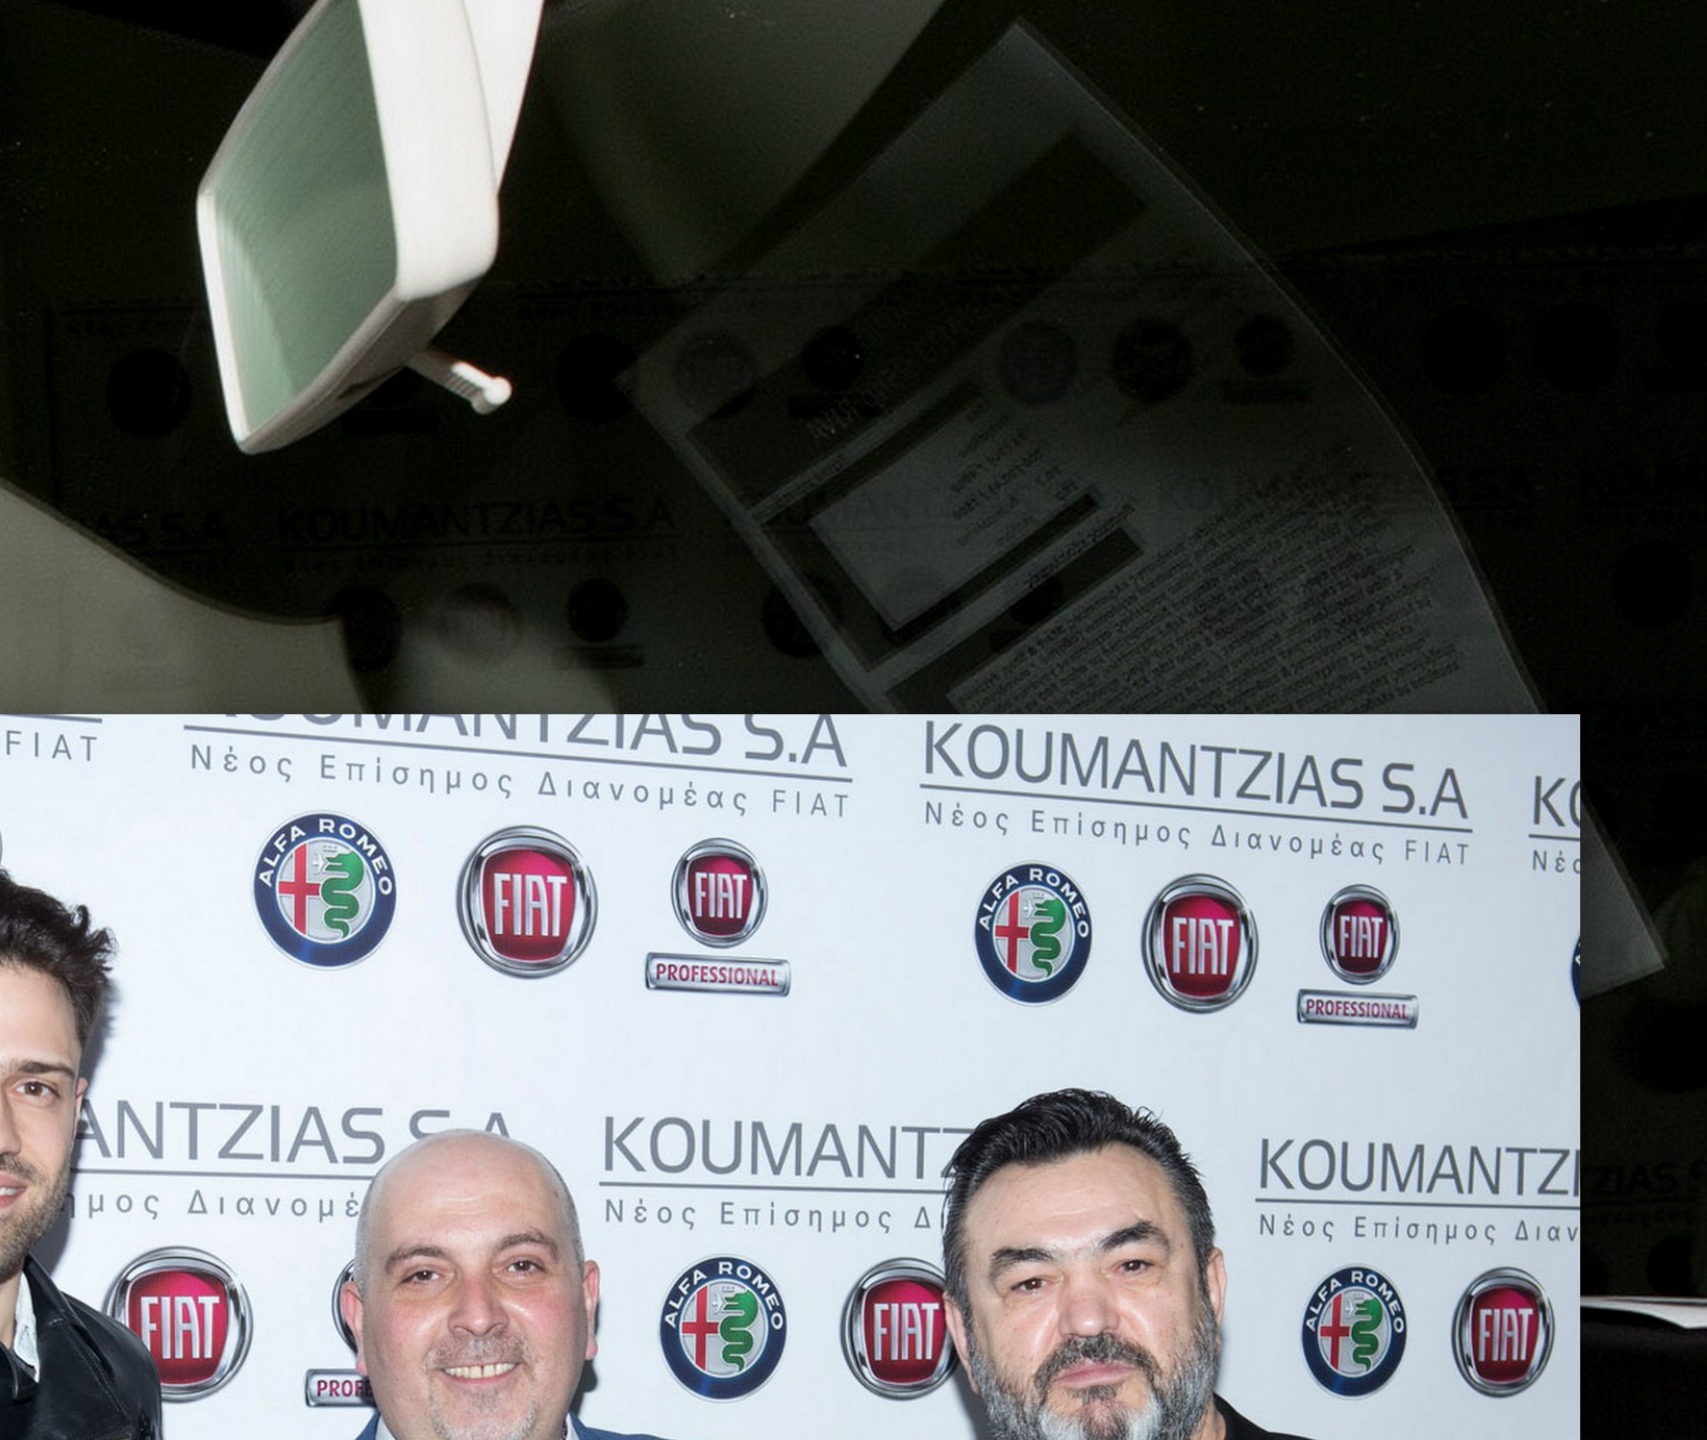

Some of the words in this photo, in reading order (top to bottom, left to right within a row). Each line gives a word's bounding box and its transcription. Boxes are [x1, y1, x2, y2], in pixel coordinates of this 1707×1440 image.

[5, 729, 98, 762] FIAT
[744, 714, 847, 767] S.A
[925, 720, 1364, 810] KOUMANTZIAS
[1382, 762, 1469, 820] S.A
[190, 743, 293, 783] Νέος
[320, 754, 513, 799] Επίσημος
[537, 771, 747, 816] Διανομέας
[772, 789, 849, 818] FIAT
[258, 824, 306, 888] ALFA
[318, 818, 393, 896] ROMEO
[925, 800, 1009, 836] Νέος
[1031, 809, 1191, 850] Επίσημος
[1210, 823, 1385, 865] Διανομέας
[1405, 839, 1470, 866] FIAT
[493, 872, 568, 938] FIAT
[694, 871, 748, 919] FIAT
[979, 873, 1019, 931] ALFA
[1029, 867, 1089, 939] ROMEO
[1172, 916, 1235, 976] FIAT
[1338, 914, 1384, 959] FIAT
[655, 962, 780, 987] PROFESSIONAL
[1305, 998, 1410, 1022] PROFESSIONAL
[604, 1198, 696, 1230] Νέος
[719, 1201, 892, 1234] Επίσημος
[1259, 1213, 1335, 1243] Νέος
[1353, 1215, 1497, 1245] Επίσημος
[664, 1269, 707, 1329] ALFA
[718, 1260, 784, 1332] ROMEO
[1305, 1277, 1342, 1333] ALFA
[1351, 1270, 1405, 1334] ROMEO
[139, 1295, 221, 1360] FIAT
[873, 1302, 940, 1362] FIAT
[1478, 1308, 1534, 1363] FIAT
